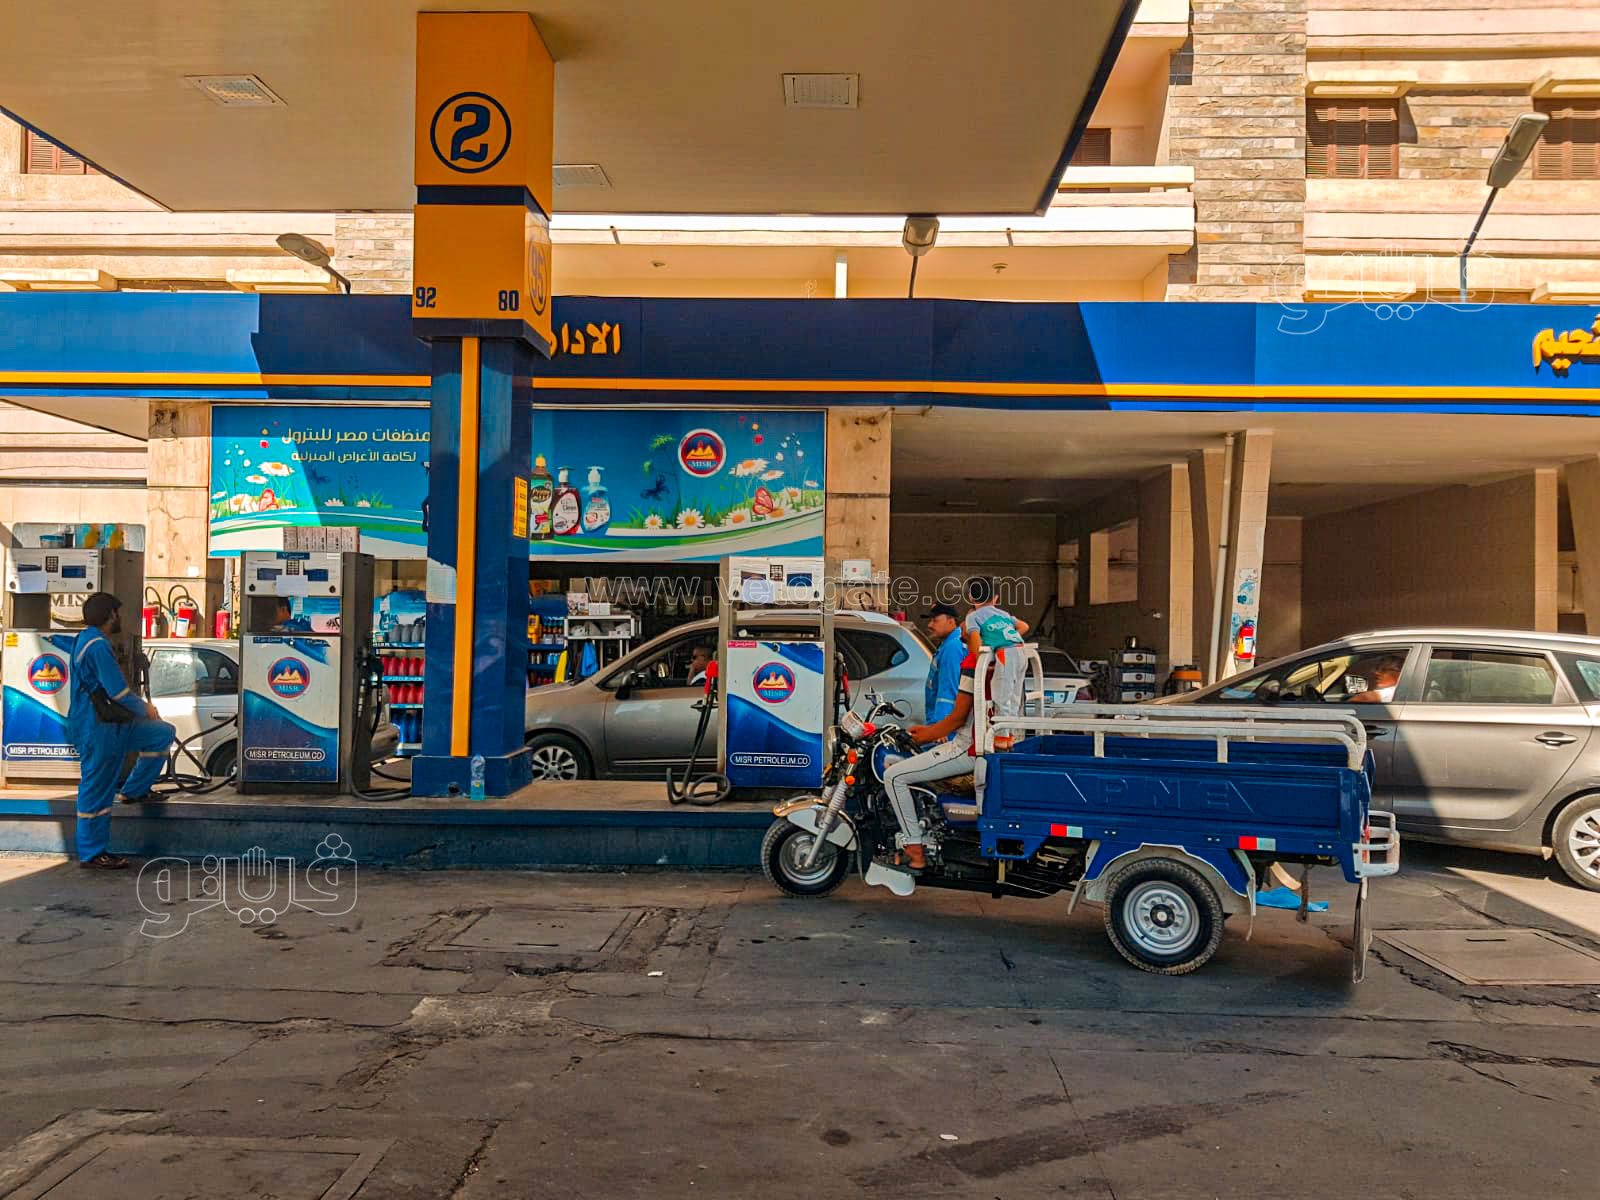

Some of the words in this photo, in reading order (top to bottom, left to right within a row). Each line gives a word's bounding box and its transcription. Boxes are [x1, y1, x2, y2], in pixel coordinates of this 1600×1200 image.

[451, 104, 490, 162] 2
[415, 287, 437, 308] 92
[498, 290, 519, 311] 80
[281, 427, 332, 444] للبترول
[335, 431, 368, 444] مصر
[9, 746, 26, 755] MISR
[249, 750, 266, 758] MISR
[735, 755, 753, 763] MISR
